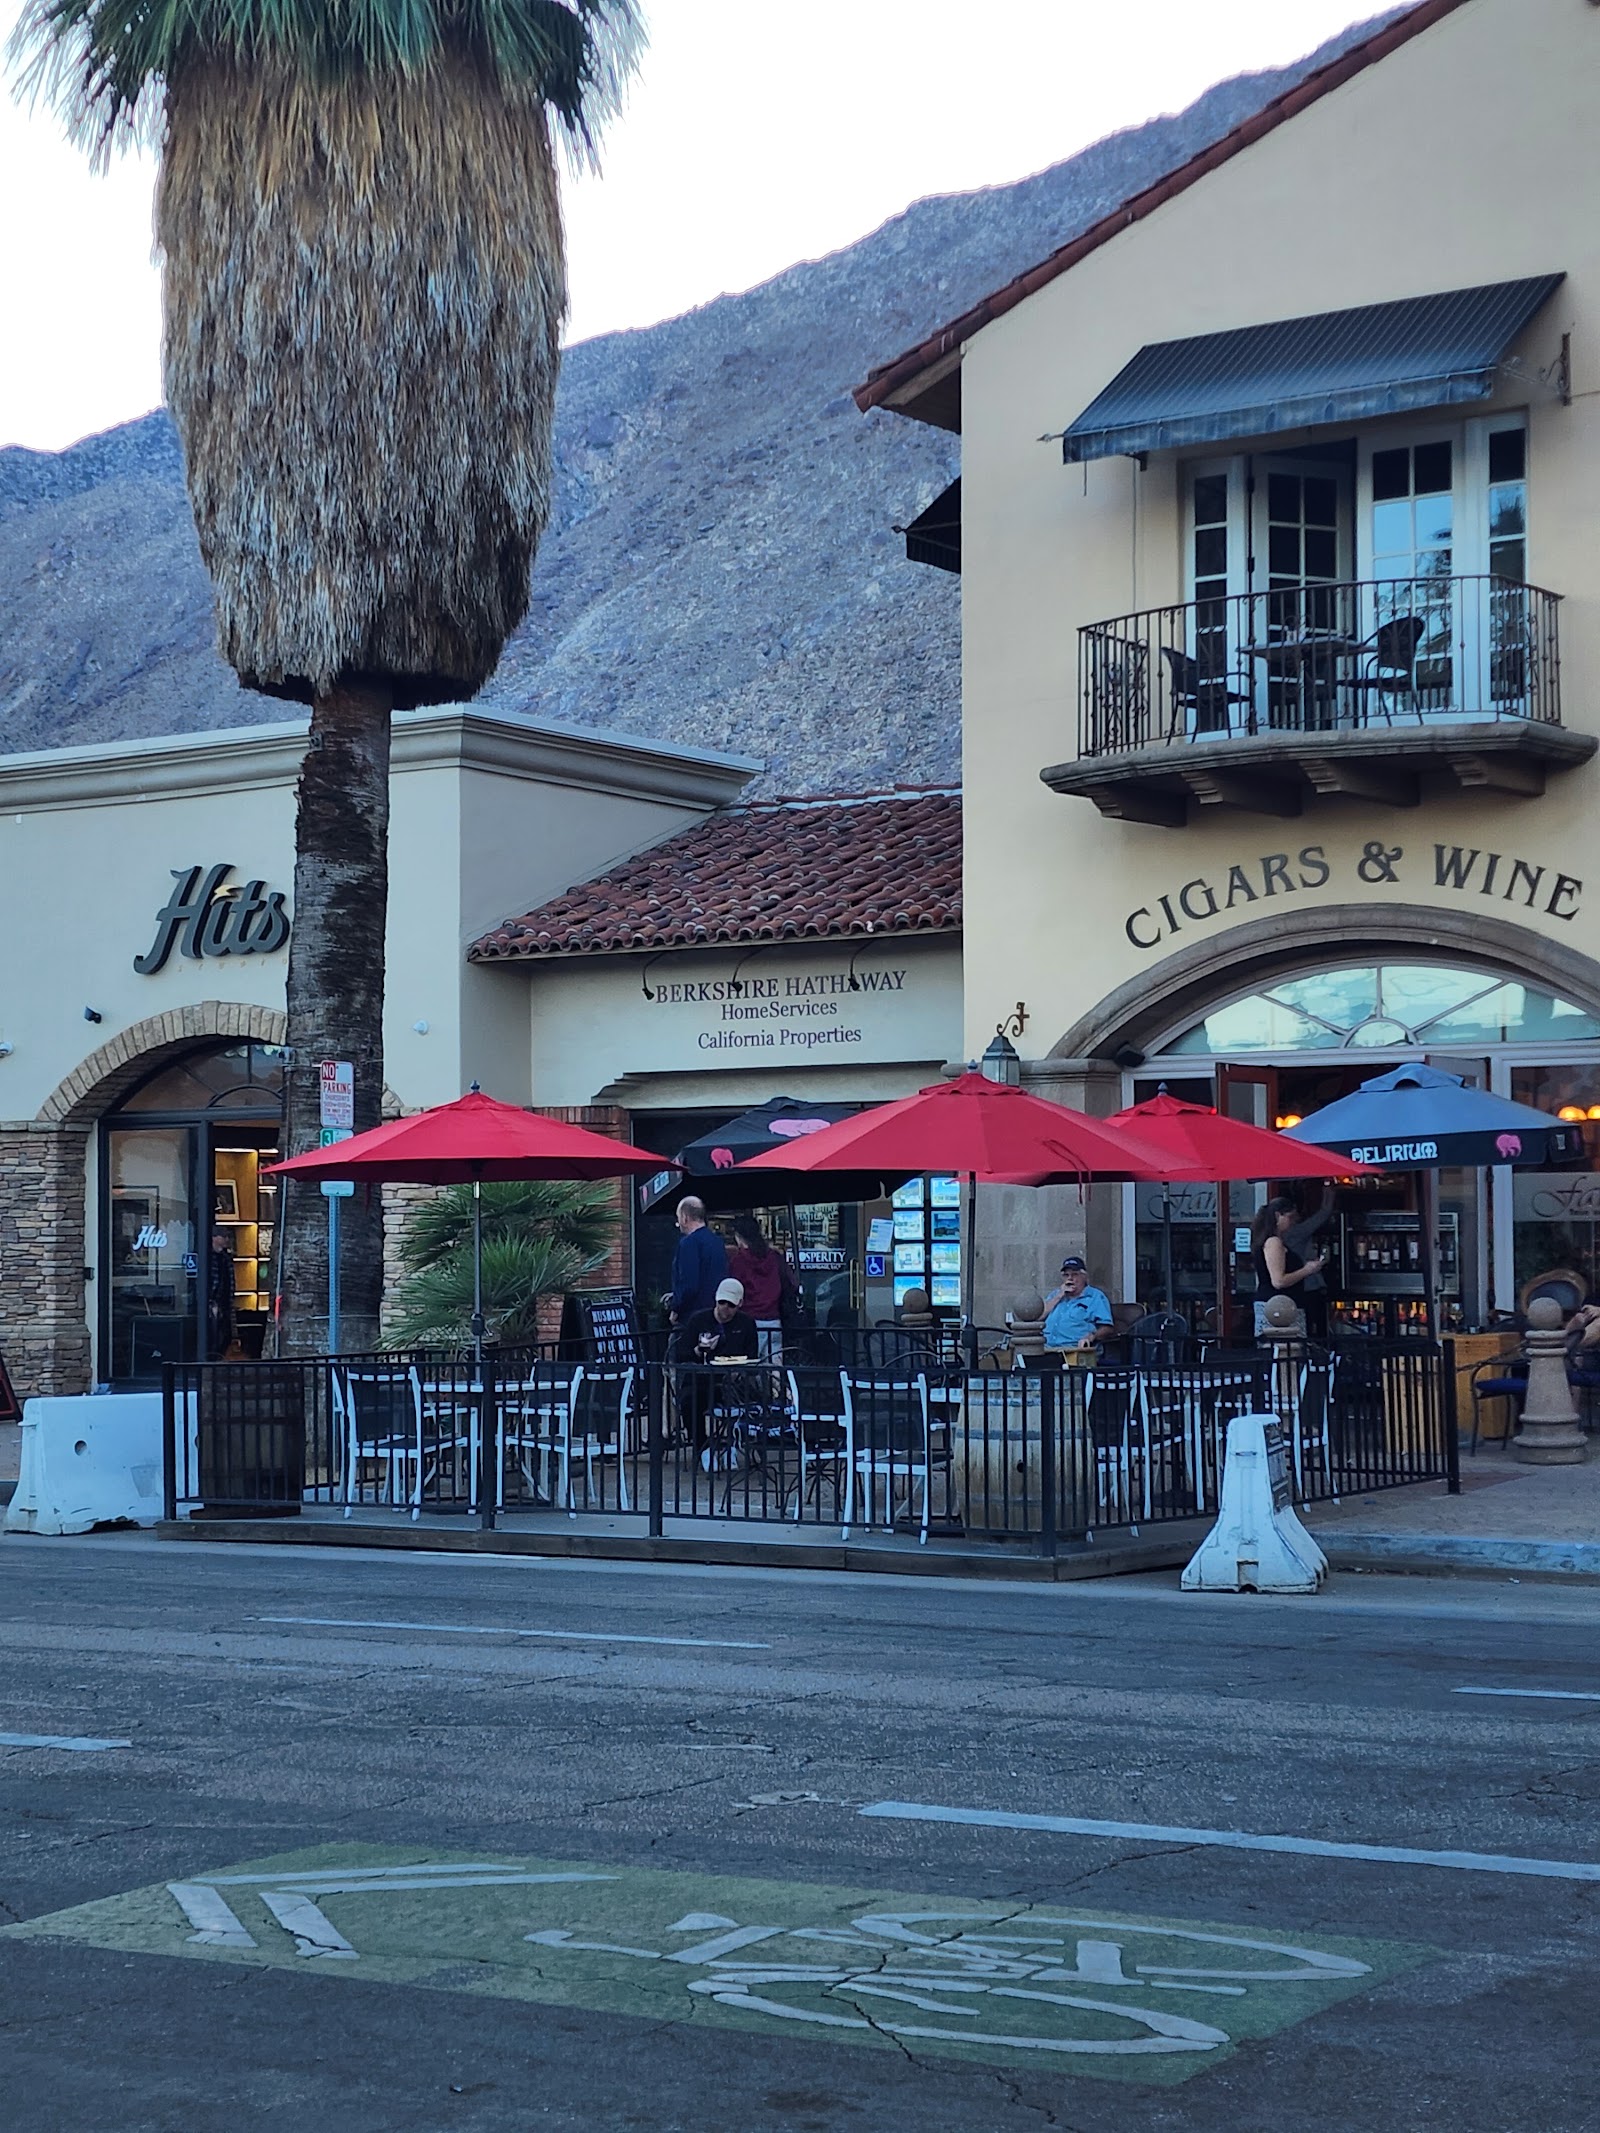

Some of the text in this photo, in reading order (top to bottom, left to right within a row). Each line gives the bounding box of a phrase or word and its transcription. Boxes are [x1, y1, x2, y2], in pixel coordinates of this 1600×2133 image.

[1124, 840, 1584, 949] CIGARS & WINE
[133, 863, 290, 975] Hits
[656, 978, 779, 1003] BERKSHIRE
[721, 999, 838, 1020] HomeServices
[698, 1025, 862, 1049] California Properties
[322, 1063, 335, 1079] NO
[323, 1081, 352, 1094] PARKING
[323, 1131, 331, 1147] 3
[1351, 1141, 1438, 1164] DELIRIUM
[132, 1224, 168, 1250] Hits
[591, 1308, 627, 1323] HUSBAND
